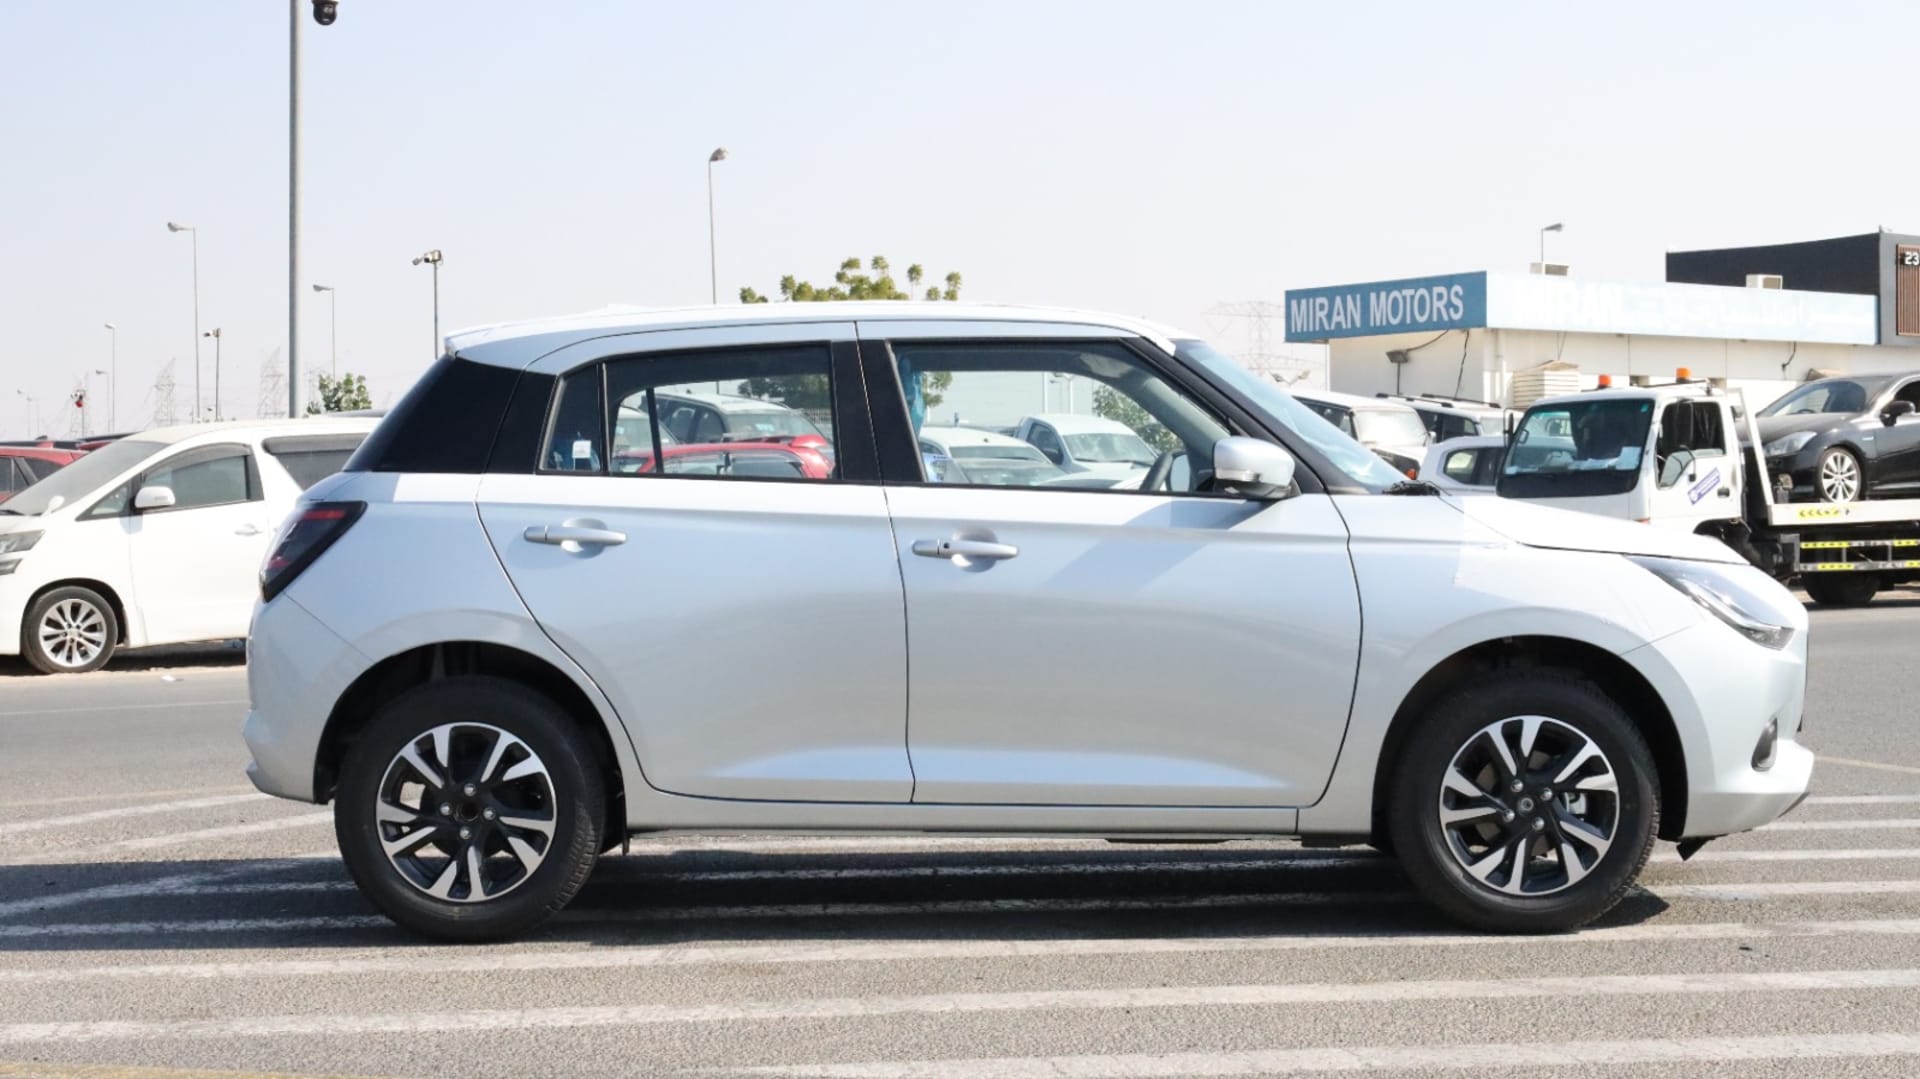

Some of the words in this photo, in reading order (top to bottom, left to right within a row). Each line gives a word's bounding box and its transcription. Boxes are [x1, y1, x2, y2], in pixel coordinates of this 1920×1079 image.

[1904, 251, 1920, 266] 23
[1291, 293, 1361, 334] MIRAN
[1369, 284, 1464, 328] MOTORS
